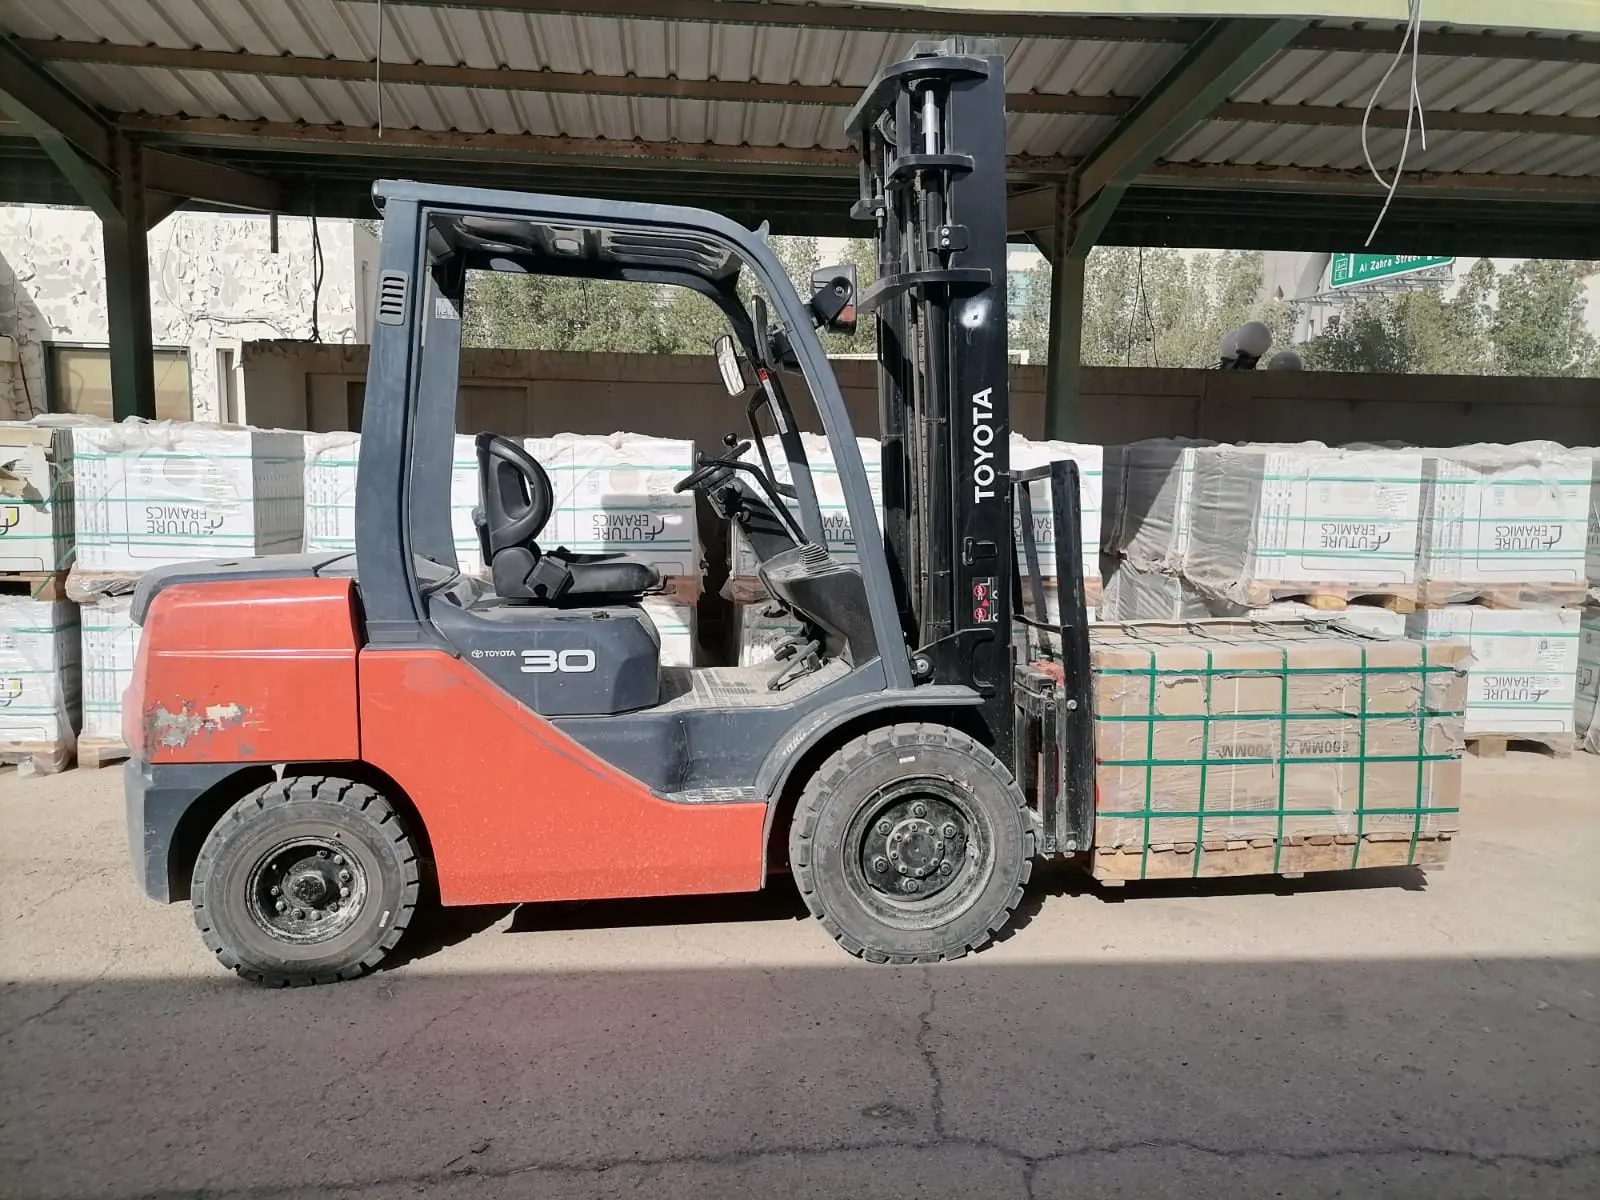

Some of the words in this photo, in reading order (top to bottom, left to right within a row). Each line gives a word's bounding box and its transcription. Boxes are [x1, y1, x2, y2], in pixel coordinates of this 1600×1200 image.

[1359, 263, 1367, 273] Al
[1370, 258, 1392, 271] Zahra
[972, 387, 995, 504] TOYOTA
[146, 520, 214, 536] FUTURE
[592, 526, 656, 541] FUTURE
[1320, 535, 1381, 552] FUTURE
[1494, 536, 1553, 551] FUTURE
[484, 649, 516, 658] TOYOTA
[520, 649, 596, 674] 30
[1483, 688, 1542, 702] FUTURE
[1222, 743, 1274, 758] 200MM
